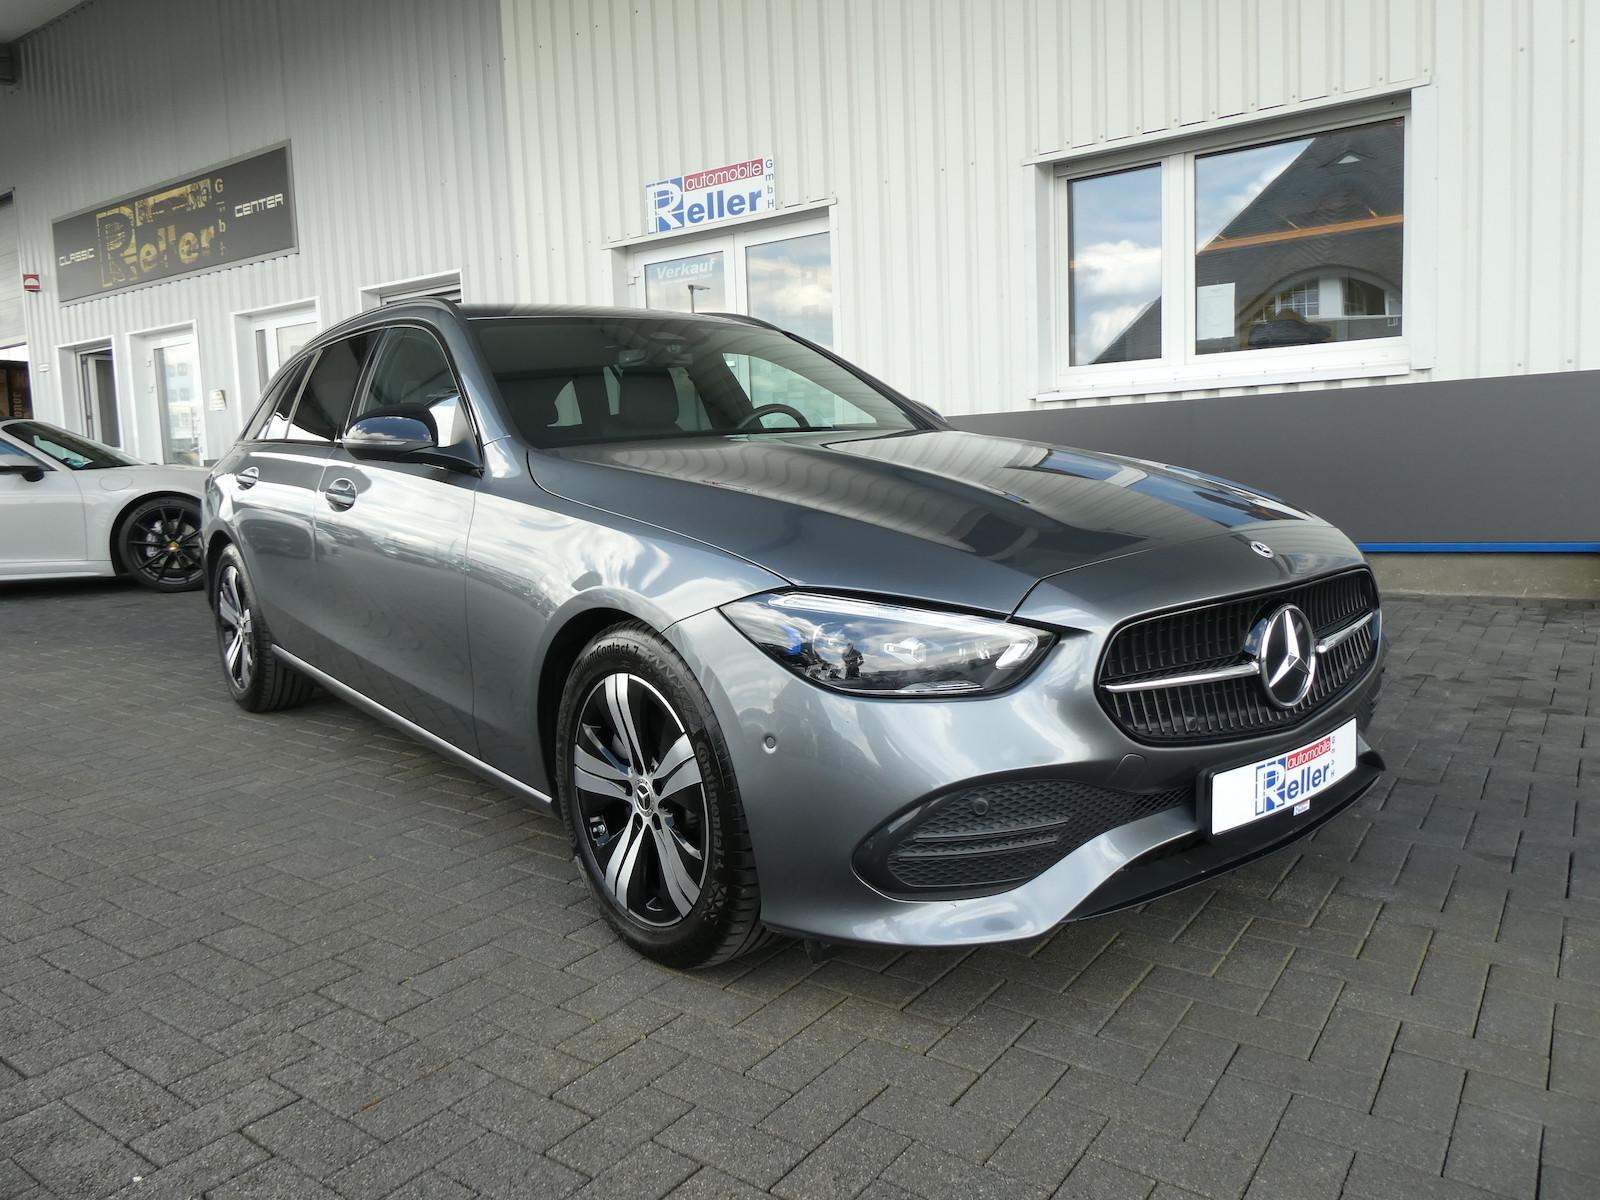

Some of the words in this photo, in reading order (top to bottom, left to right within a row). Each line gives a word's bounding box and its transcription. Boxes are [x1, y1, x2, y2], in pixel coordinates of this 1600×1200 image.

[686, 161, 762, 191] automobile
[765, 159, 775, 209] GmbH
[234, 192, 285, 218] CENTER
[645, 176, 763, 234] Reller
[656, 258, 717, 280] Verkauf
[1287, 740, 1331, 770] automobile
[1255, 757, 1330, 816] Reller
